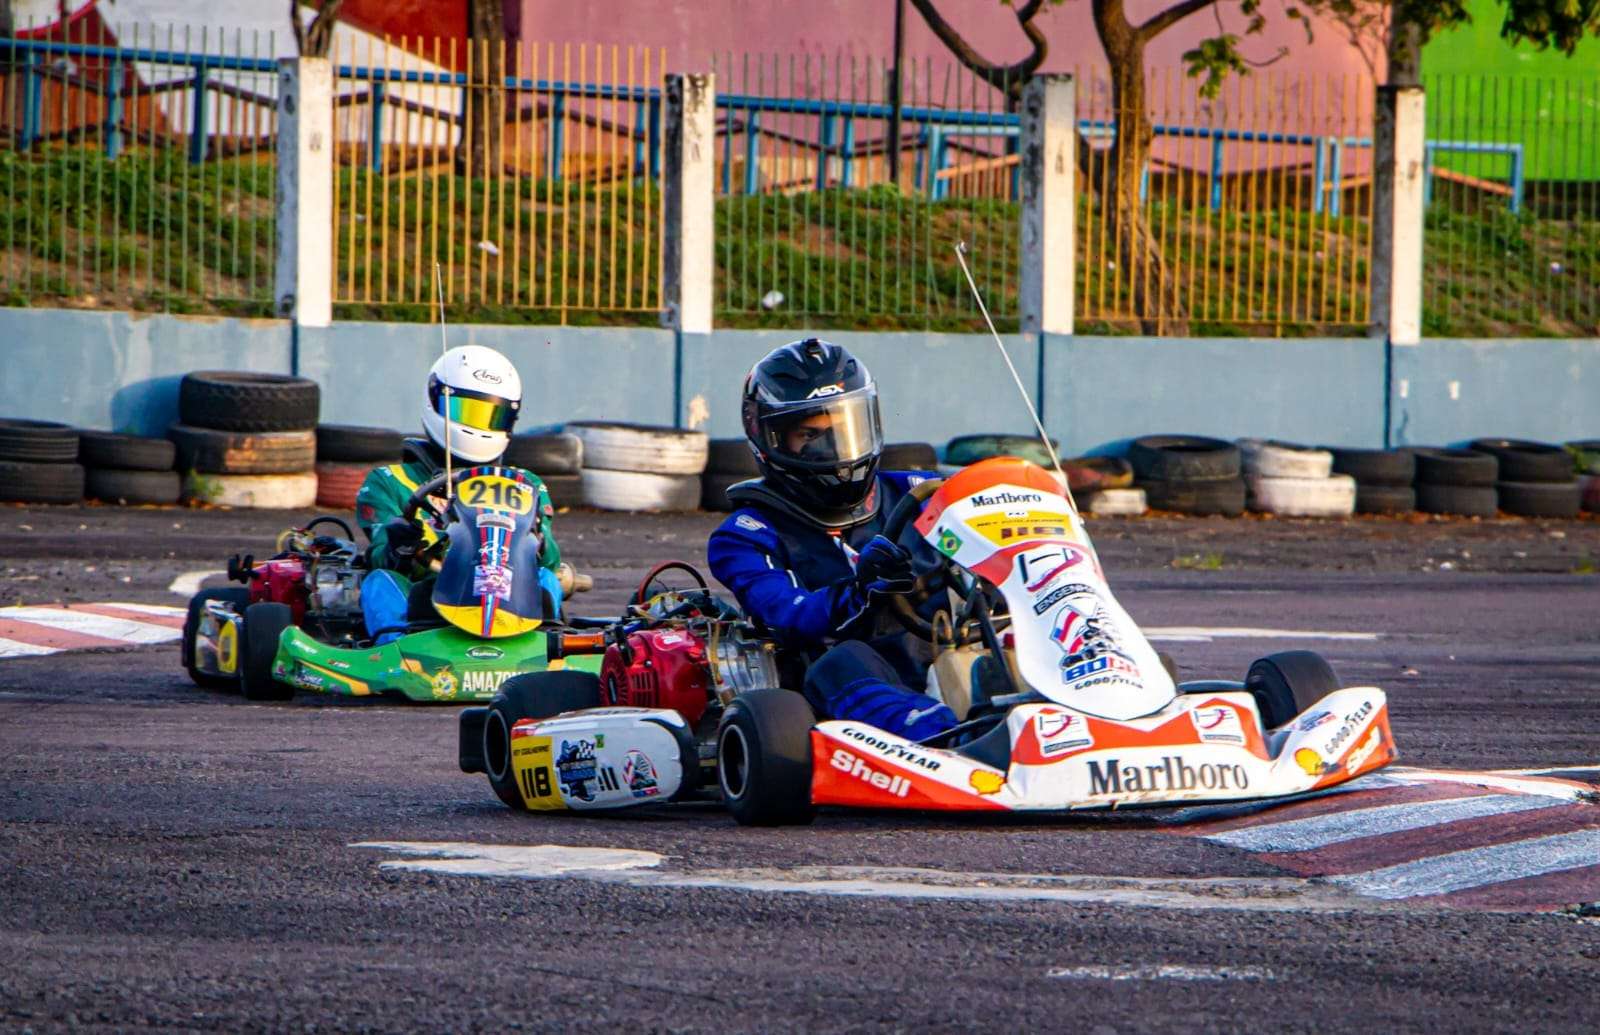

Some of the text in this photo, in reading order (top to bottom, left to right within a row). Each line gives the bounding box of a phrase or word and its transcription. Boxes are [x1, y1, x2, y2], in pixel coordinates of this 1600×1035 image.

[806, 382, 846, 399] ASX
[469, 480, 523, 510] 216
[971, 493, 1041, 507] Marlboro
[842, 727, 942, 772] GOODYEAR
[521, 766, 552, 799] 118
[830, 748, 912, 797] Shell
[1086, 756, 1249, 797] Marlboro
